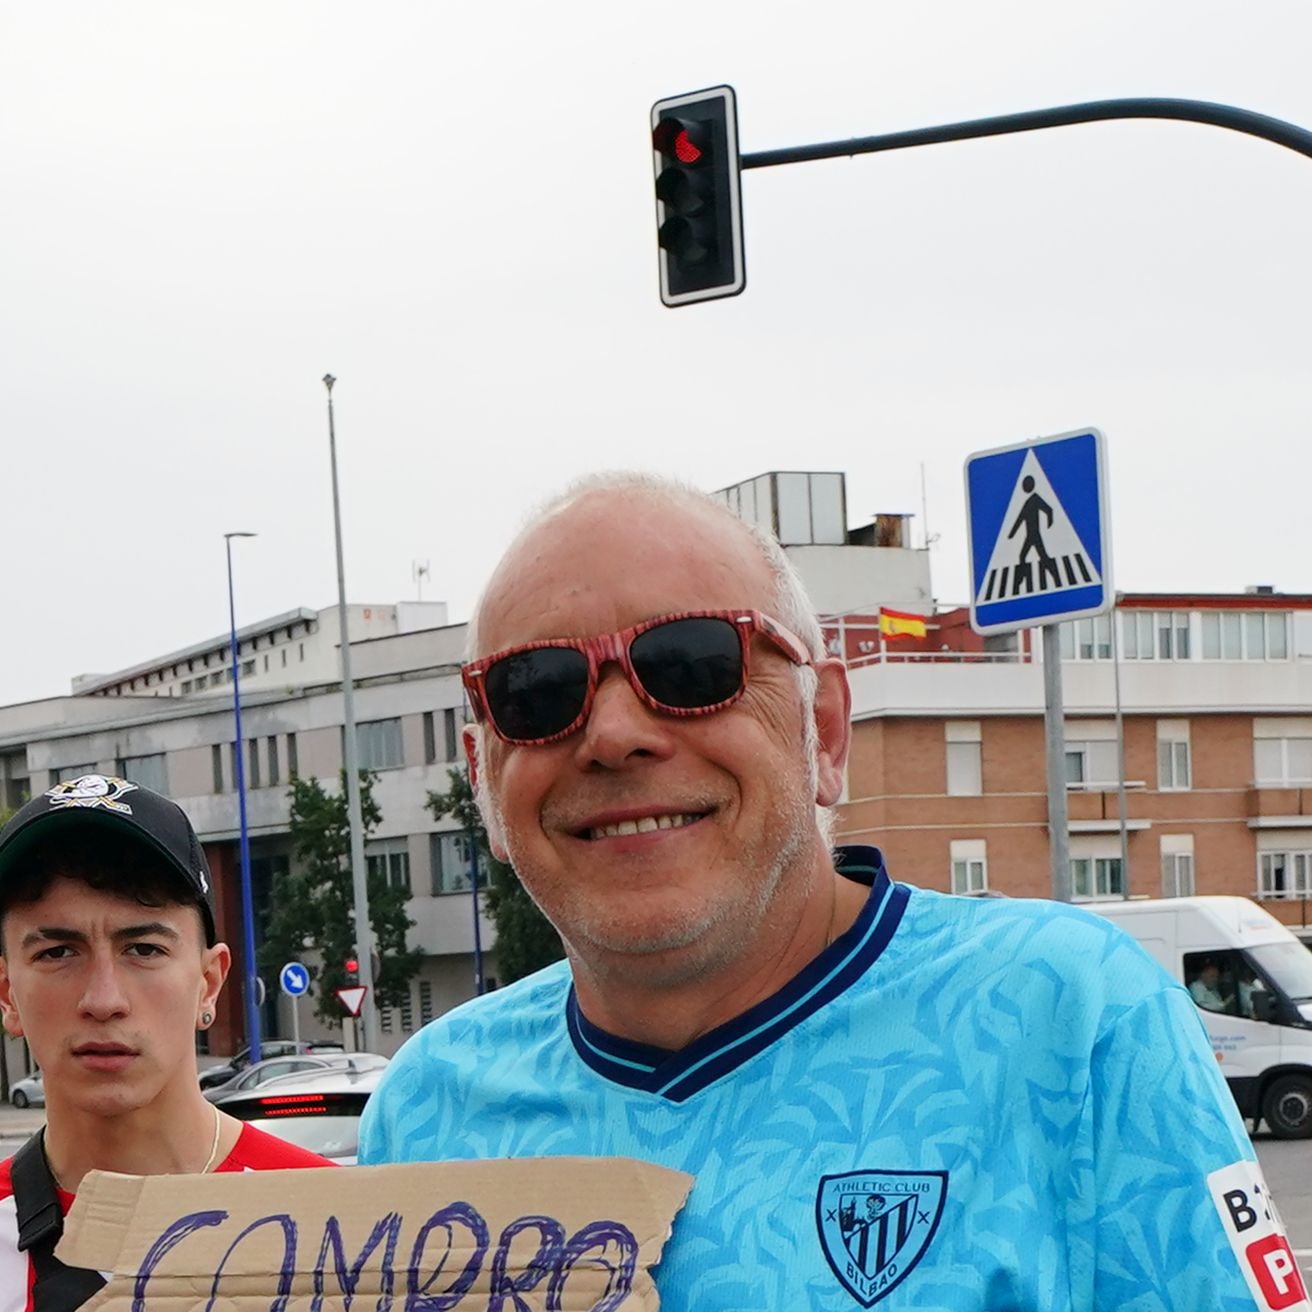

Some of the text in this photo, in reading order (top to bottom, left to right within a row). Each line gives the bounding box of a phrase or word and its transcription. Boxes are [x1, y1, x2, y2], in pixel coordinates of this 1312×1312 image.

[832, 1181, 930, 1193] ATHLETIC CLUB
[845, 1262, 898, 1297] BILBAO
